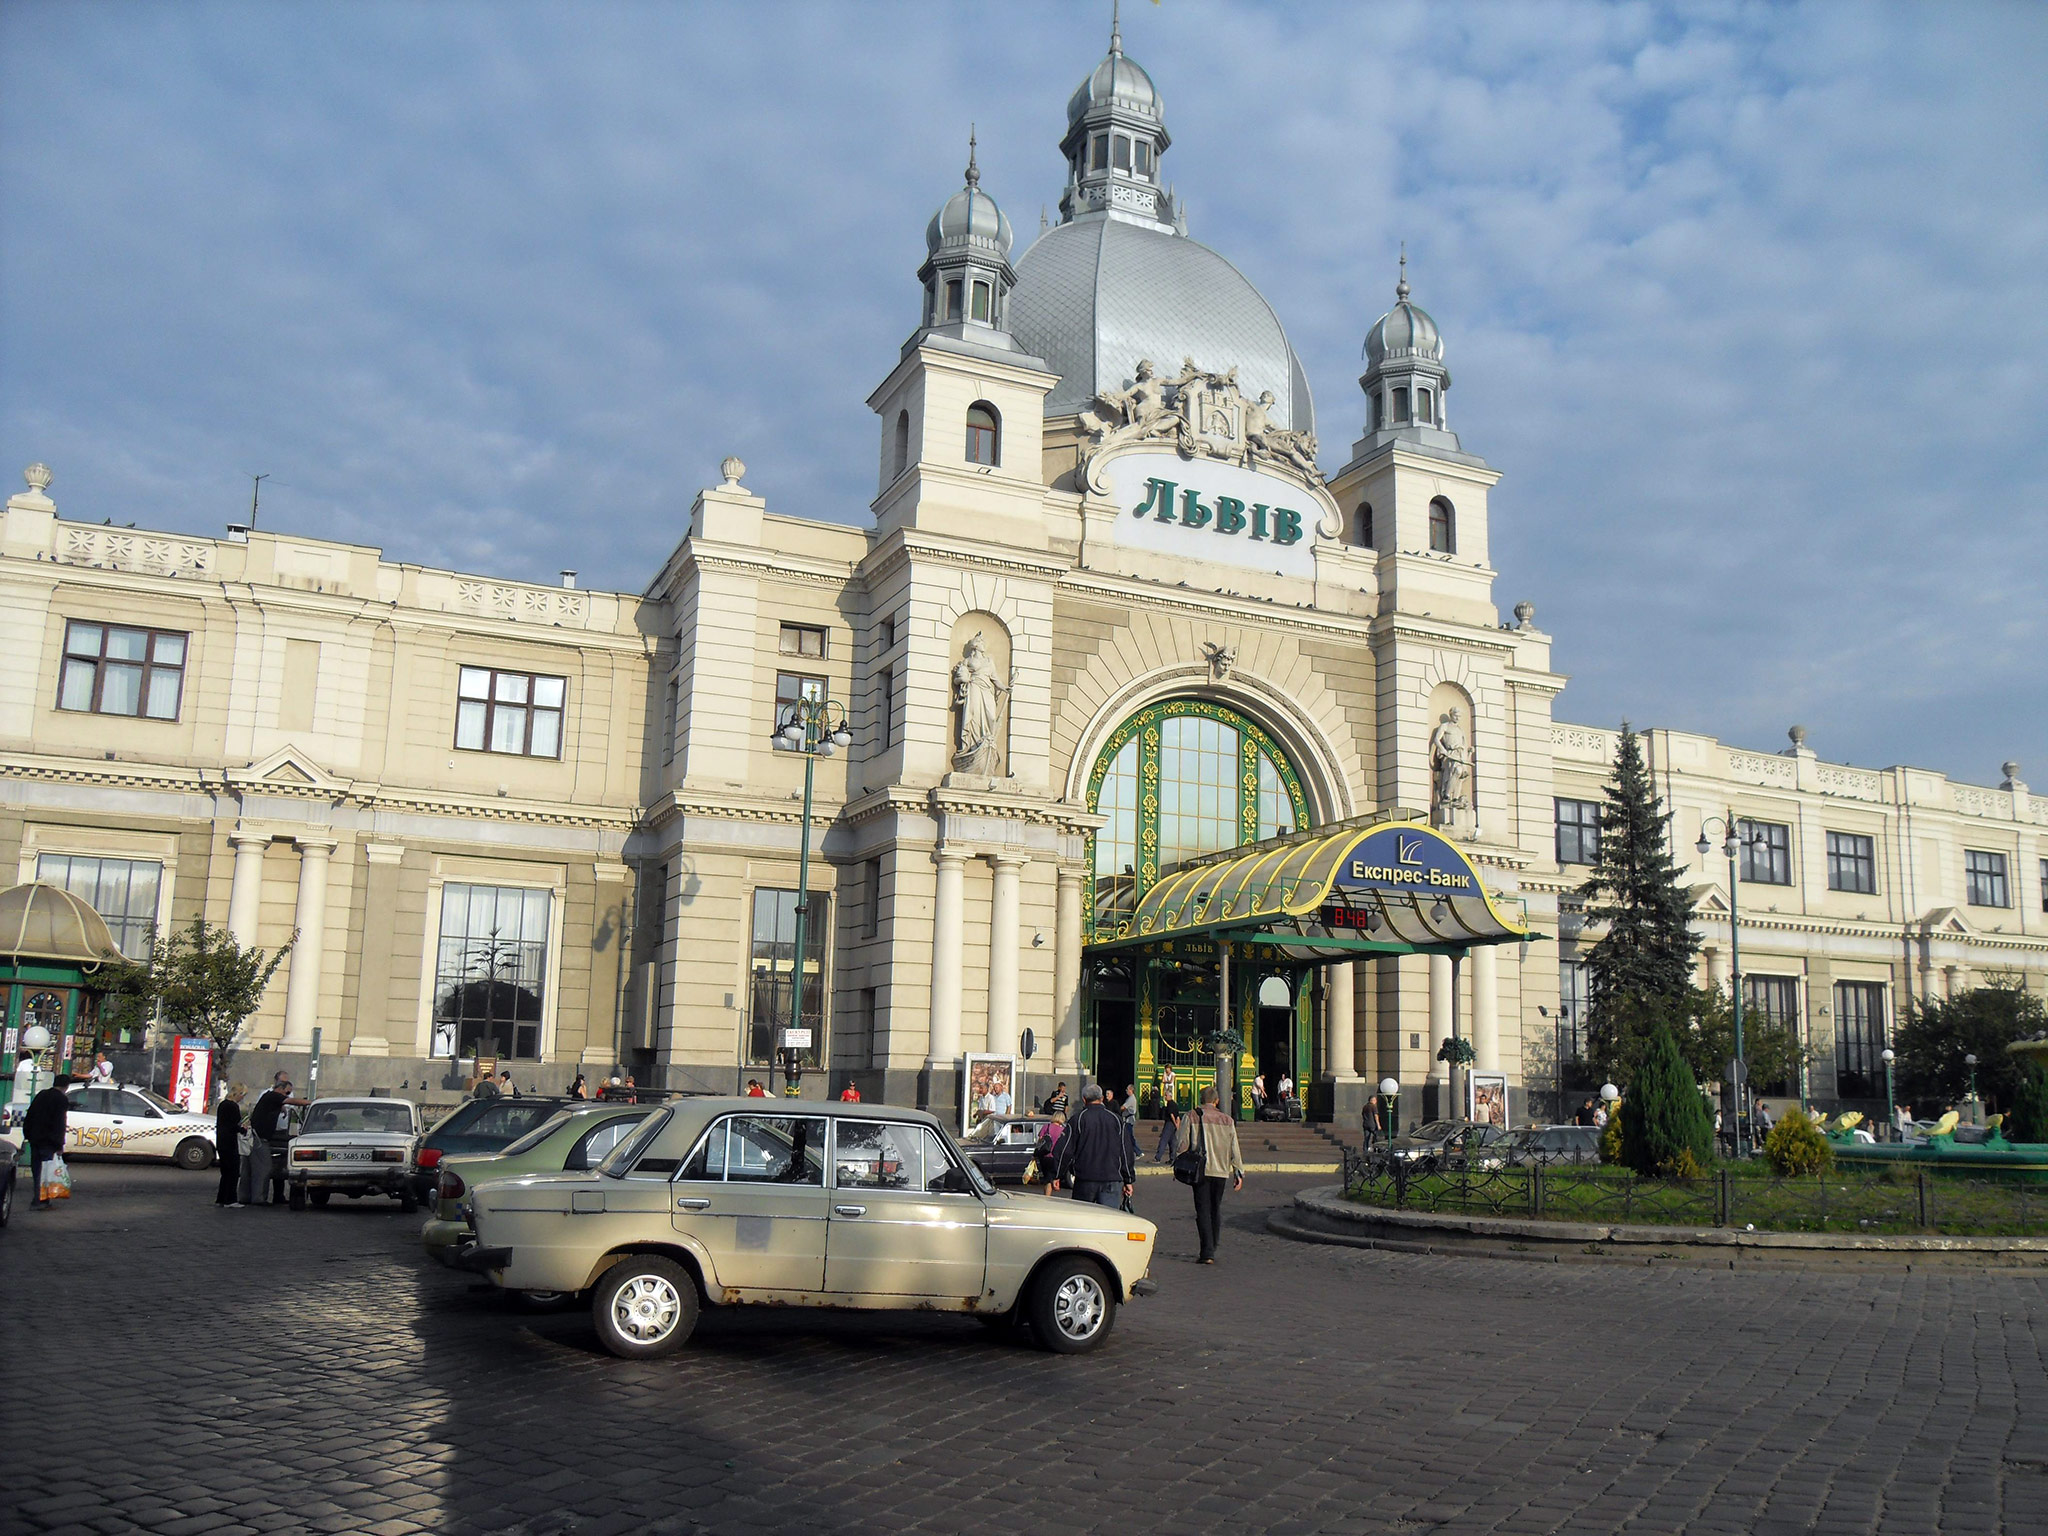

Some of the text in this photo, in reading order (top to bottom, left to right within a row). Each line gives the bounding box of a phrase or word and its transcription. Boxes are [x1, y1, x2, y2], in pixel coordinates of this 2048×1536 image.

[1134, 477, 1303, 545] ЛЬВІВ
[1352, 860, 1470, 888] Експрес-Банк
[74, 1127, 124, 1148] 1502
[331, 1152, 342, 1160] BC
